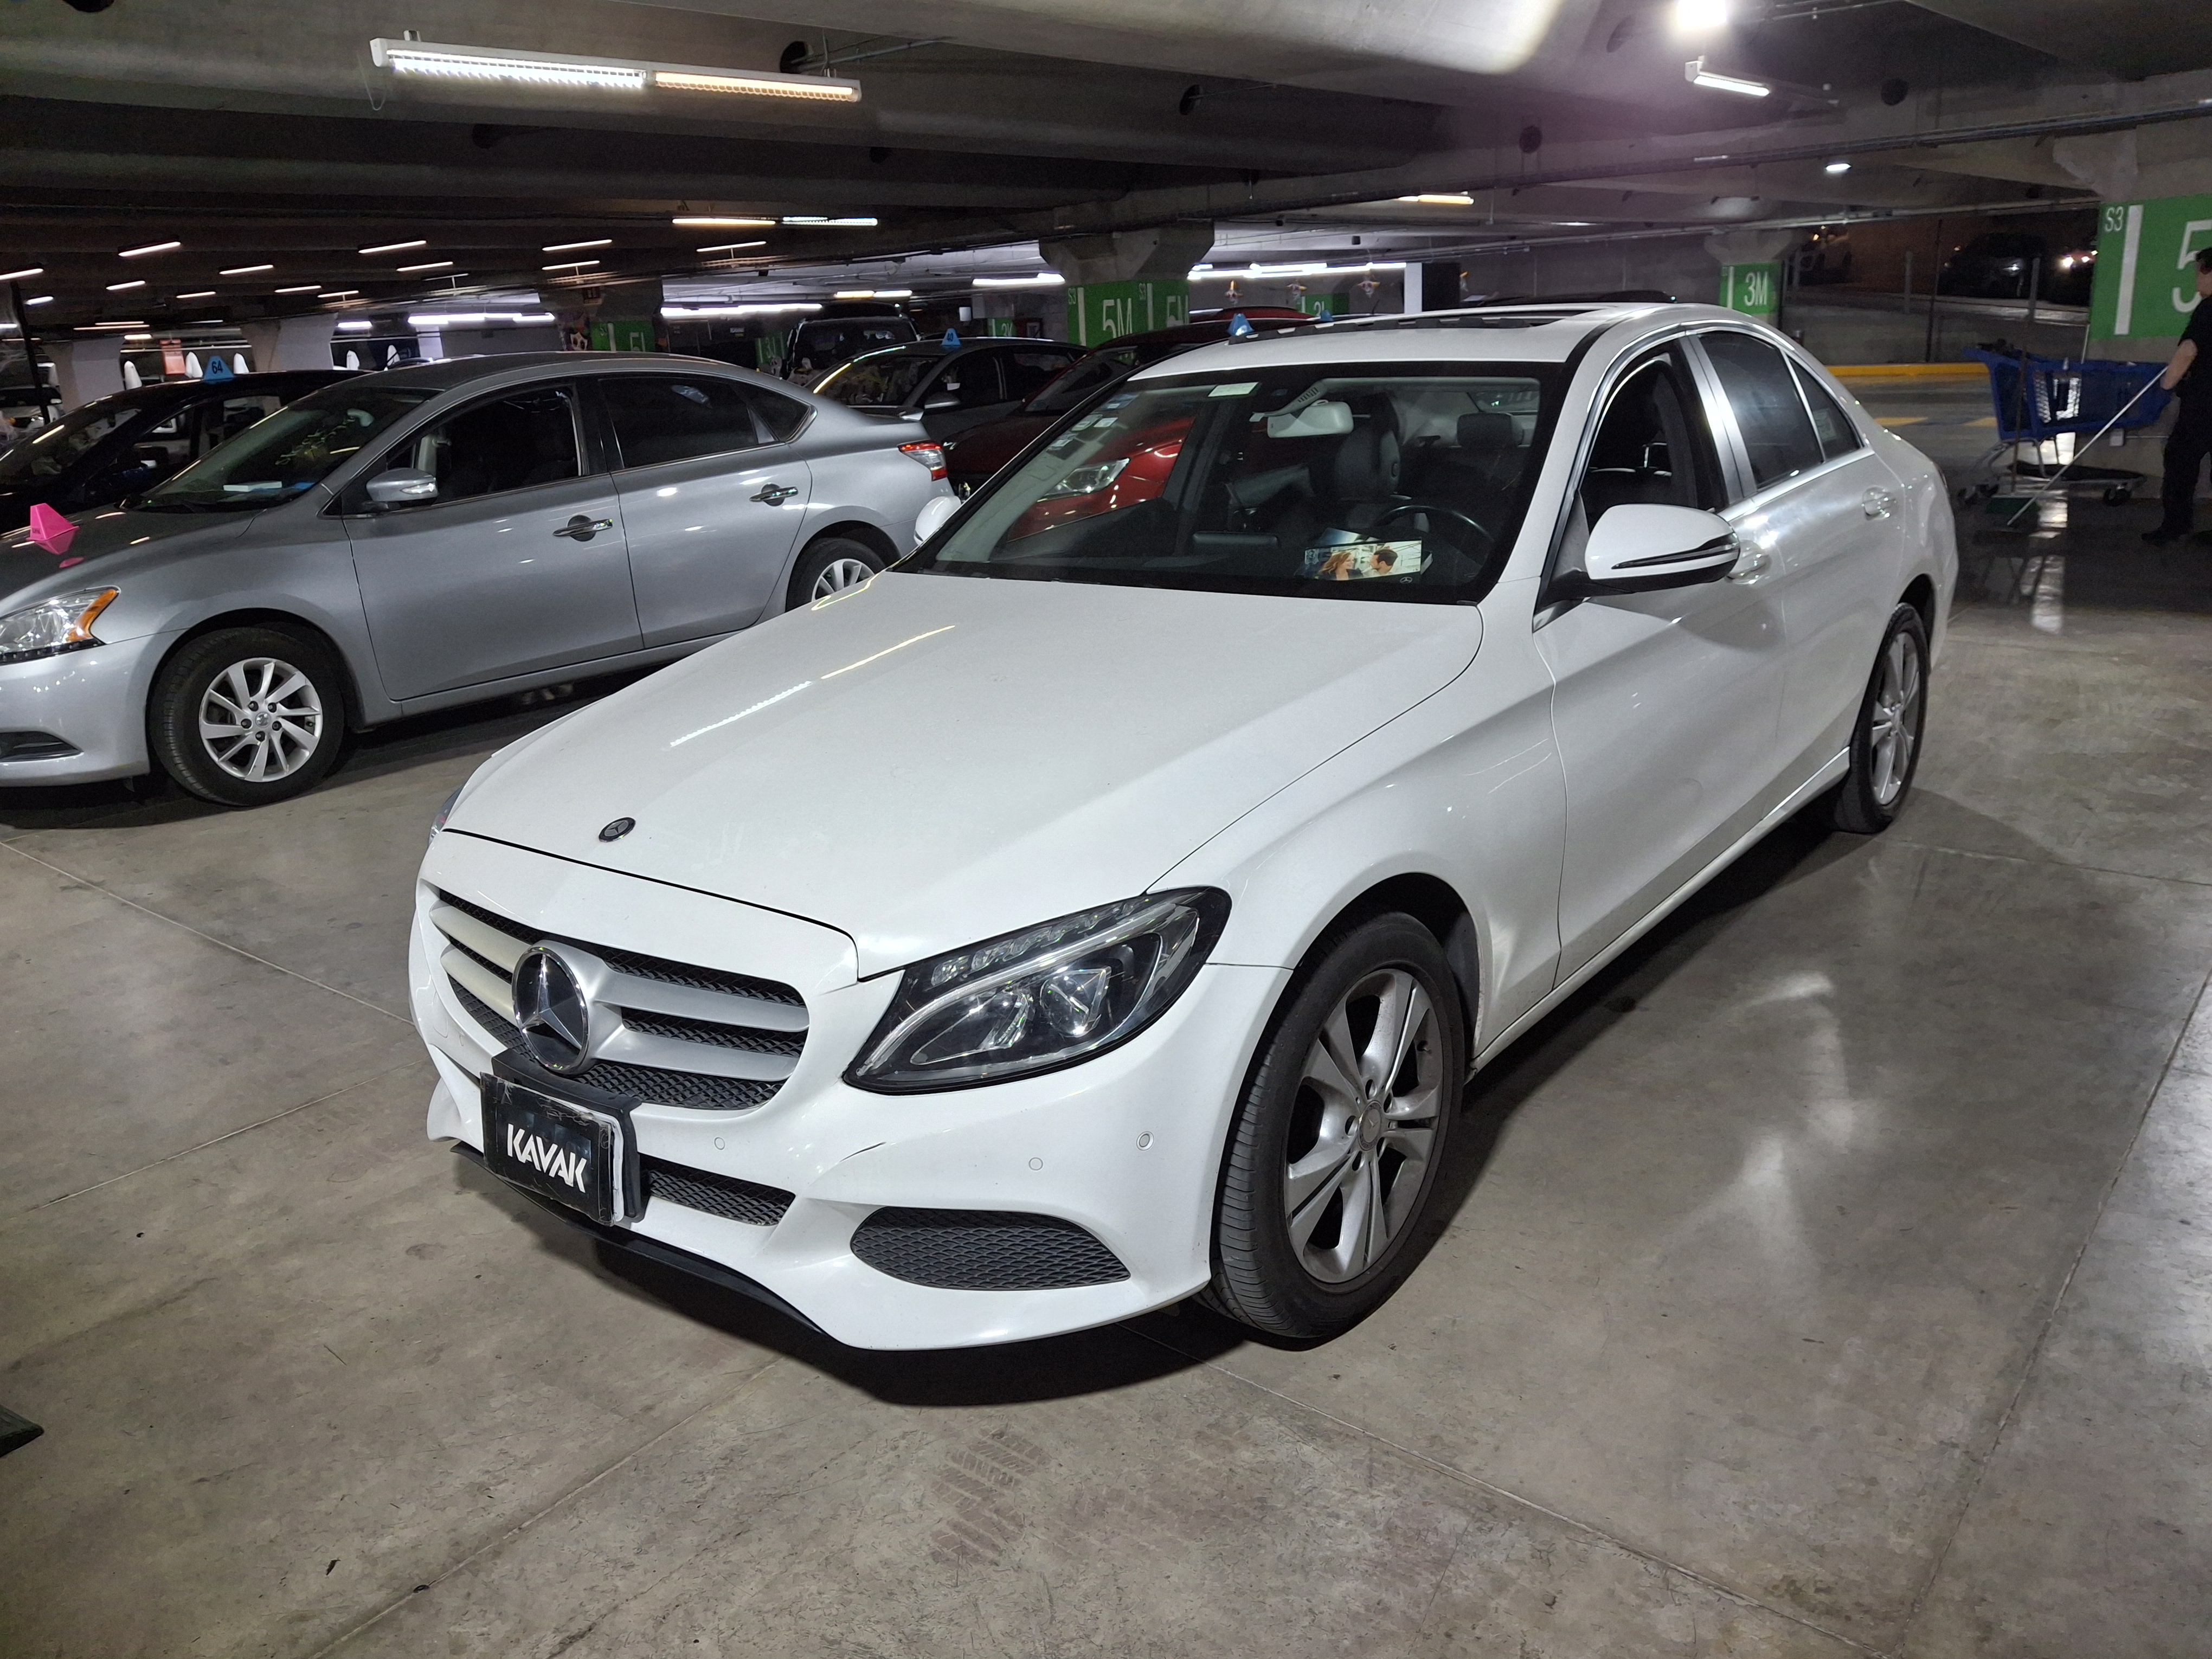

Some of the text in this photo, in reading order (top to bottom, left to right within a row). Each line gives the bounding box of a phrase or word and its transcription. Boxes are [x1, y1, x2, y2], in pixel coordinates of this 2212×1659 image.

[2104, 205, 2124, 233] S3
[1068, 288, 1076, 305] S3
[1744, 272, 1768, 306] 3M
[1103, 298, 1133, 338] 5M
[212, 361, 223, 374] 64
[507, 1123, 587, 1193] KAVAK
